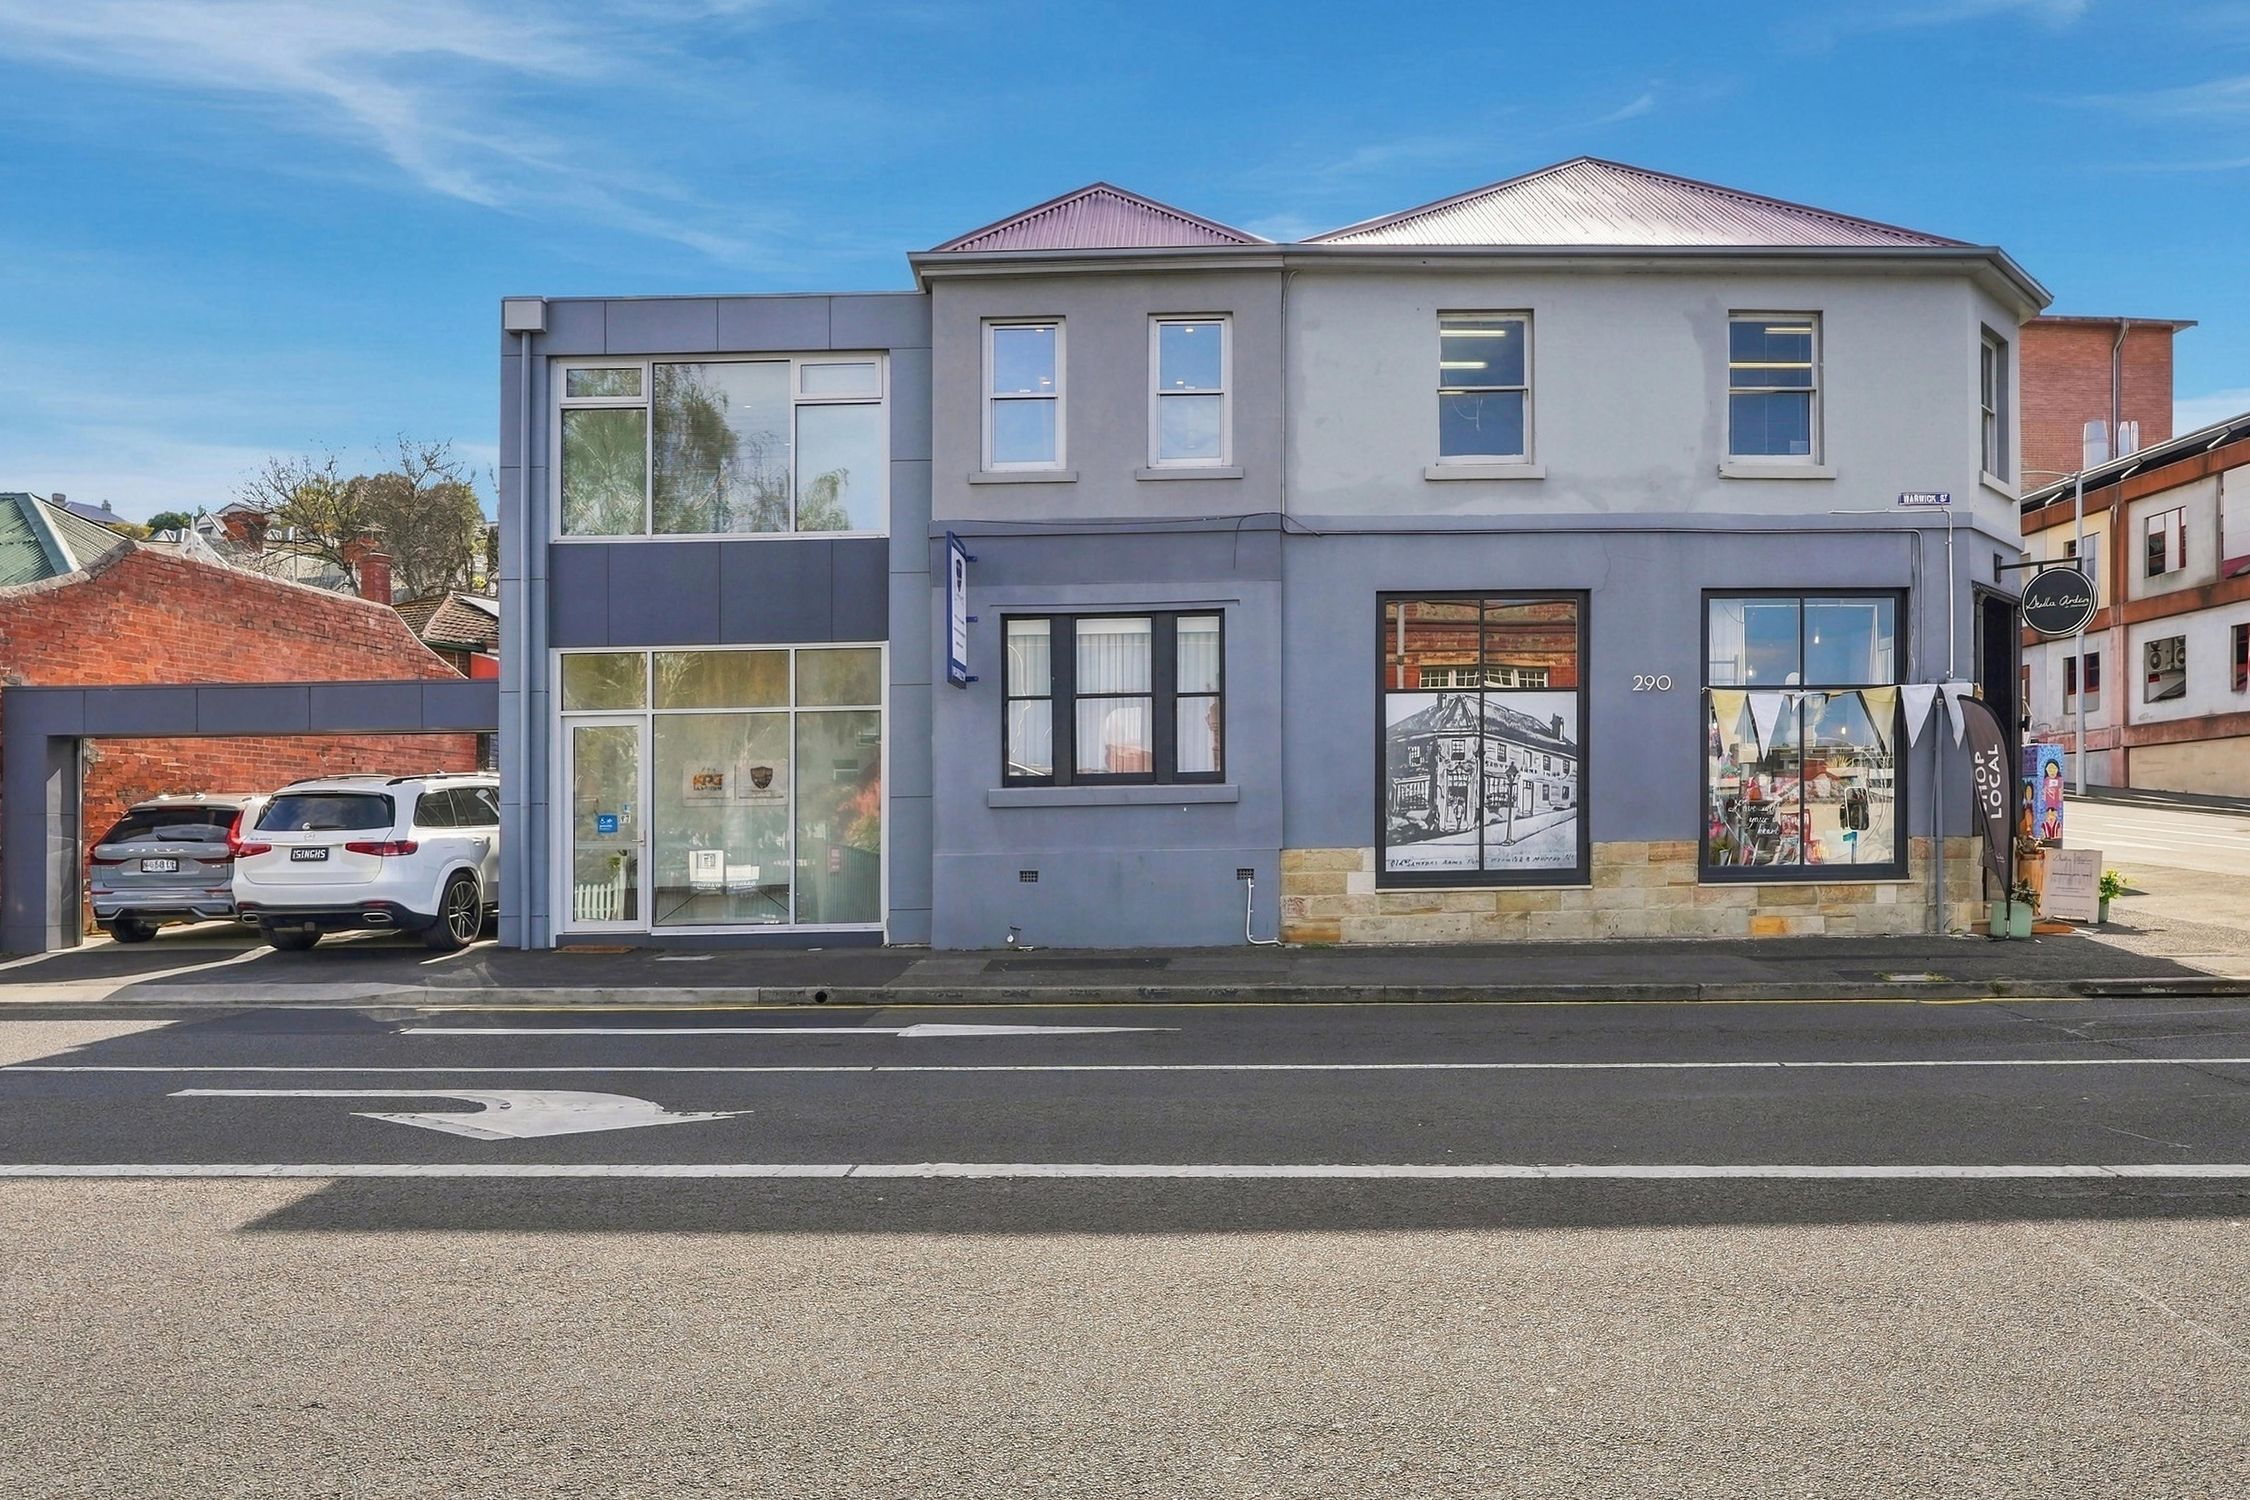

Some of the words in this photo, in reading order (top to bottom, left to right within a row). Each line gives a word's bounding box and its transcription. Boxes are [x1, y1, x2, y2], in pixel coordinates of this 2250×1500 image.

[1903, 494, 1937, 503] WARWICK
[2025, 594, 2056, 610] Stella
[1632, 674, 1672, 691] 290
[1987, 744, 2003, 819] LOCAL
